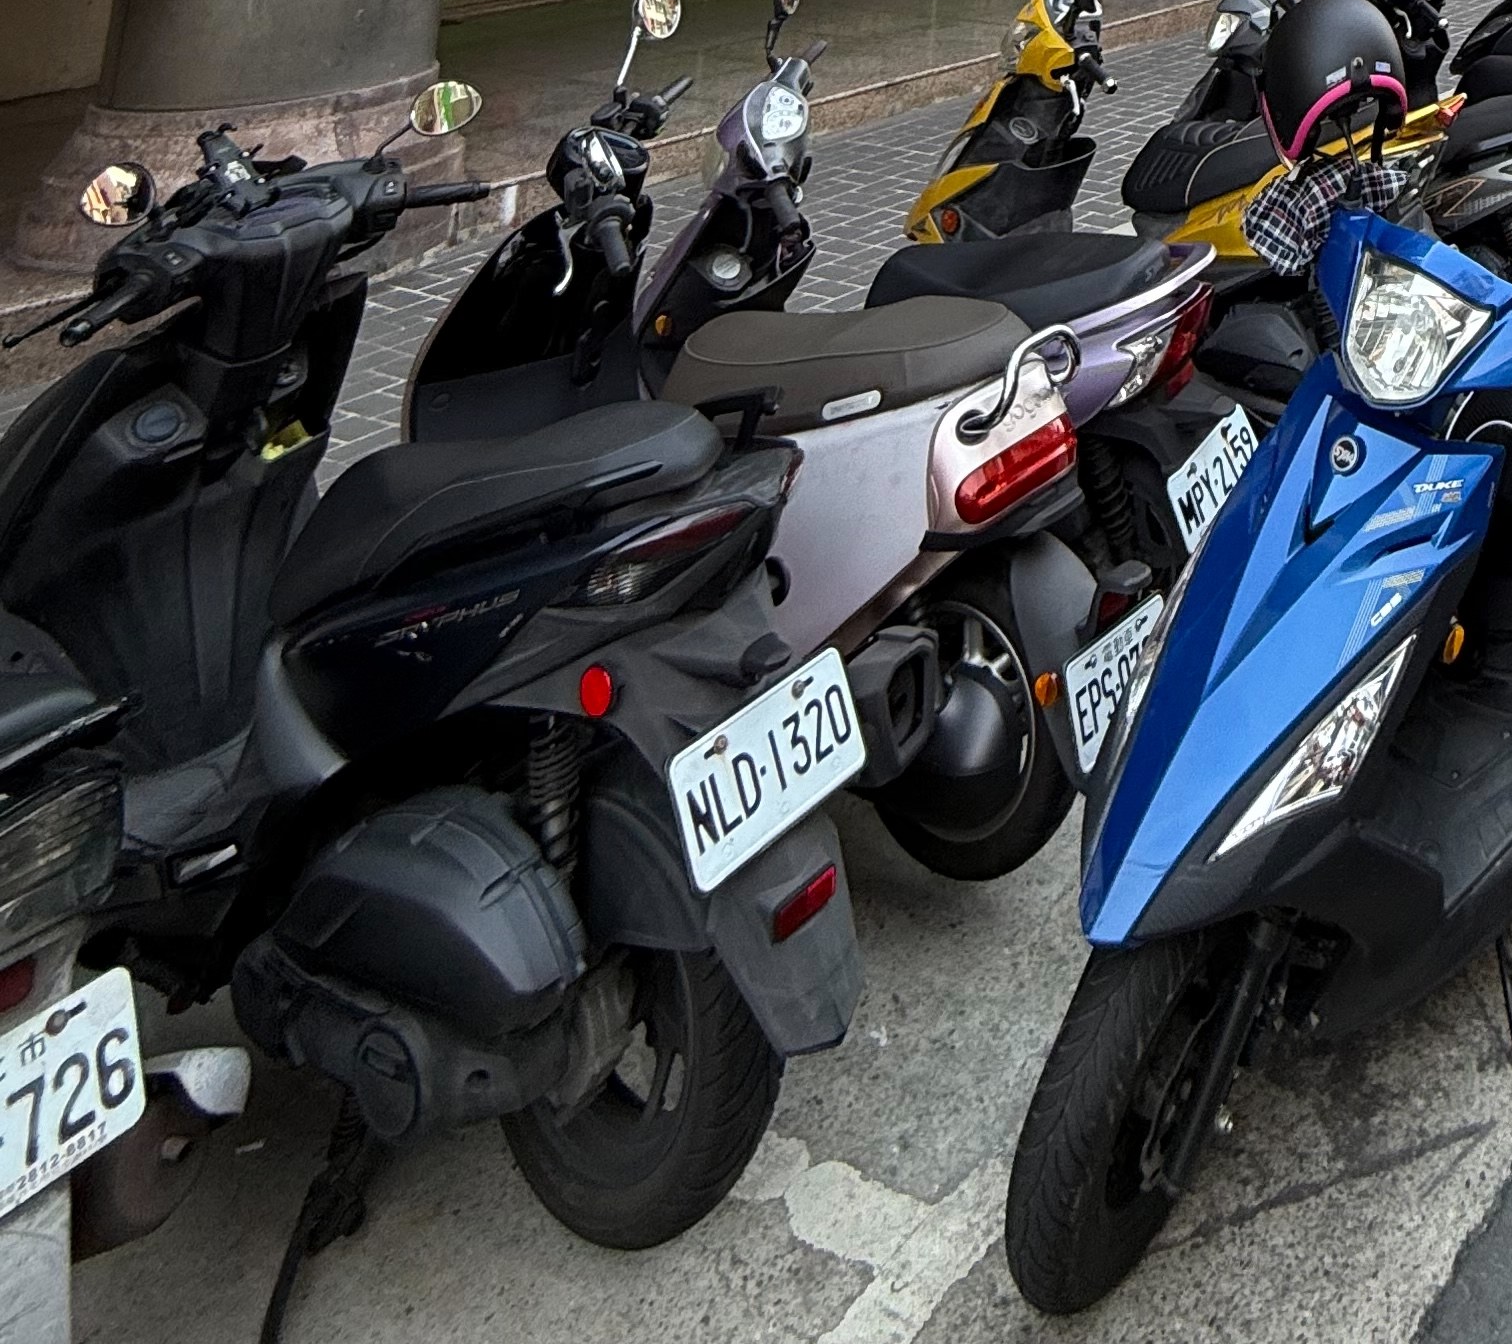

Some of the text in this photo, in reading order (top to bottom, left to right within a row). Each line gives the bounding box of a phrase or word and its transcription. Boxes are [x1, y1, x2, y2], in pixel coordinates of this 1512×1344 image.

[1177, 425, 1251, 535] MPY-2159
[1075, 634, 1152, 748] EPS-07
[1101, 623, 1134, 663] 電動車
[686, 684, 852, 857] NLD-1320
[0, 1027, 136, 1168] 726
